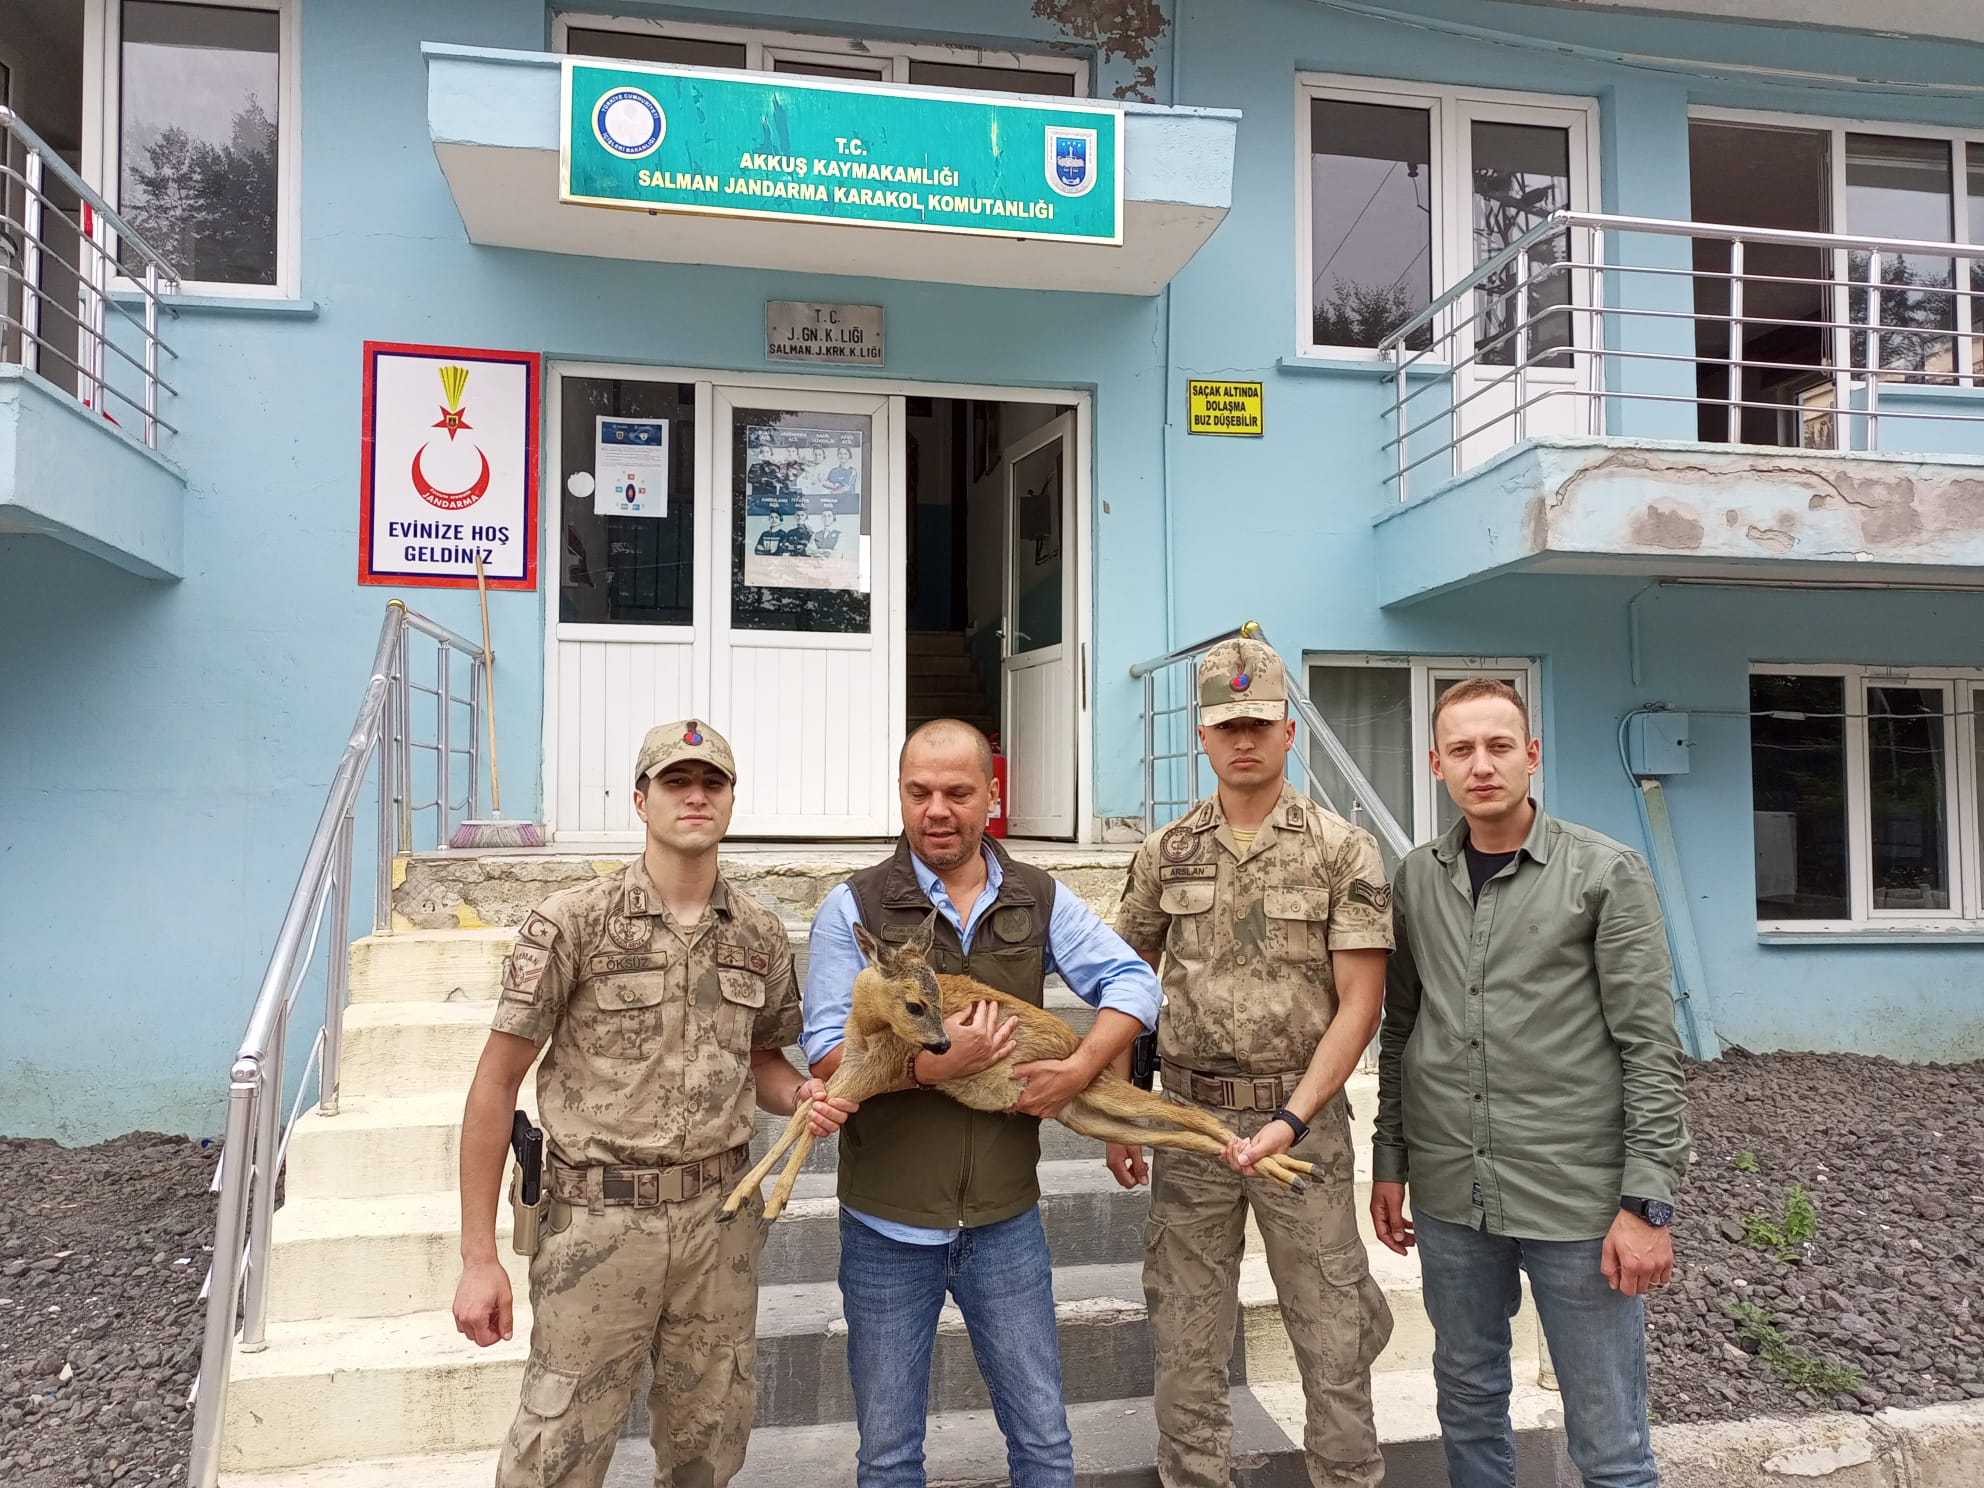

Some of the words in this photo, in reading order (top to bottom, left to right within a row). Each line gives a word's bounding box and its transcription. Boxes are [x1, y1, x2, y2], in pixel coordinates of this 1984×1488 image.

[835, 136, 868, 155] T.C.
[740, 152, 808, 177] AKKUŞ
[813, 158, 959, 187] KAYMAKAMLIĞI
[638, 169, 719, 193] SALMAN
[724, 179, 828, 201] JANDARMA
[834, 186, 922, 208] KARAKOL
[928, 193, 1054, 220] KOMUTANLIĞI
[1192, 385, 1221, 399] SAÇAK
[1223, 386, 1259, 398] ALTINDA
[1206, 400, 1246, 414] DOLAŞMA
[1194, 414, 1211, 426] BUZ
[1213, 413, 1258, 429] DÜŞEBİLİR
[422, 492, 480, 509] JANDARMA
[389, 519, 465, 541] EVİNİZE
[472, 525, 510, 546] HOŞ
[1170, 867, 1205, 876] ARSLAN
[606, 956, 649, 971] ÖKSÜZ
